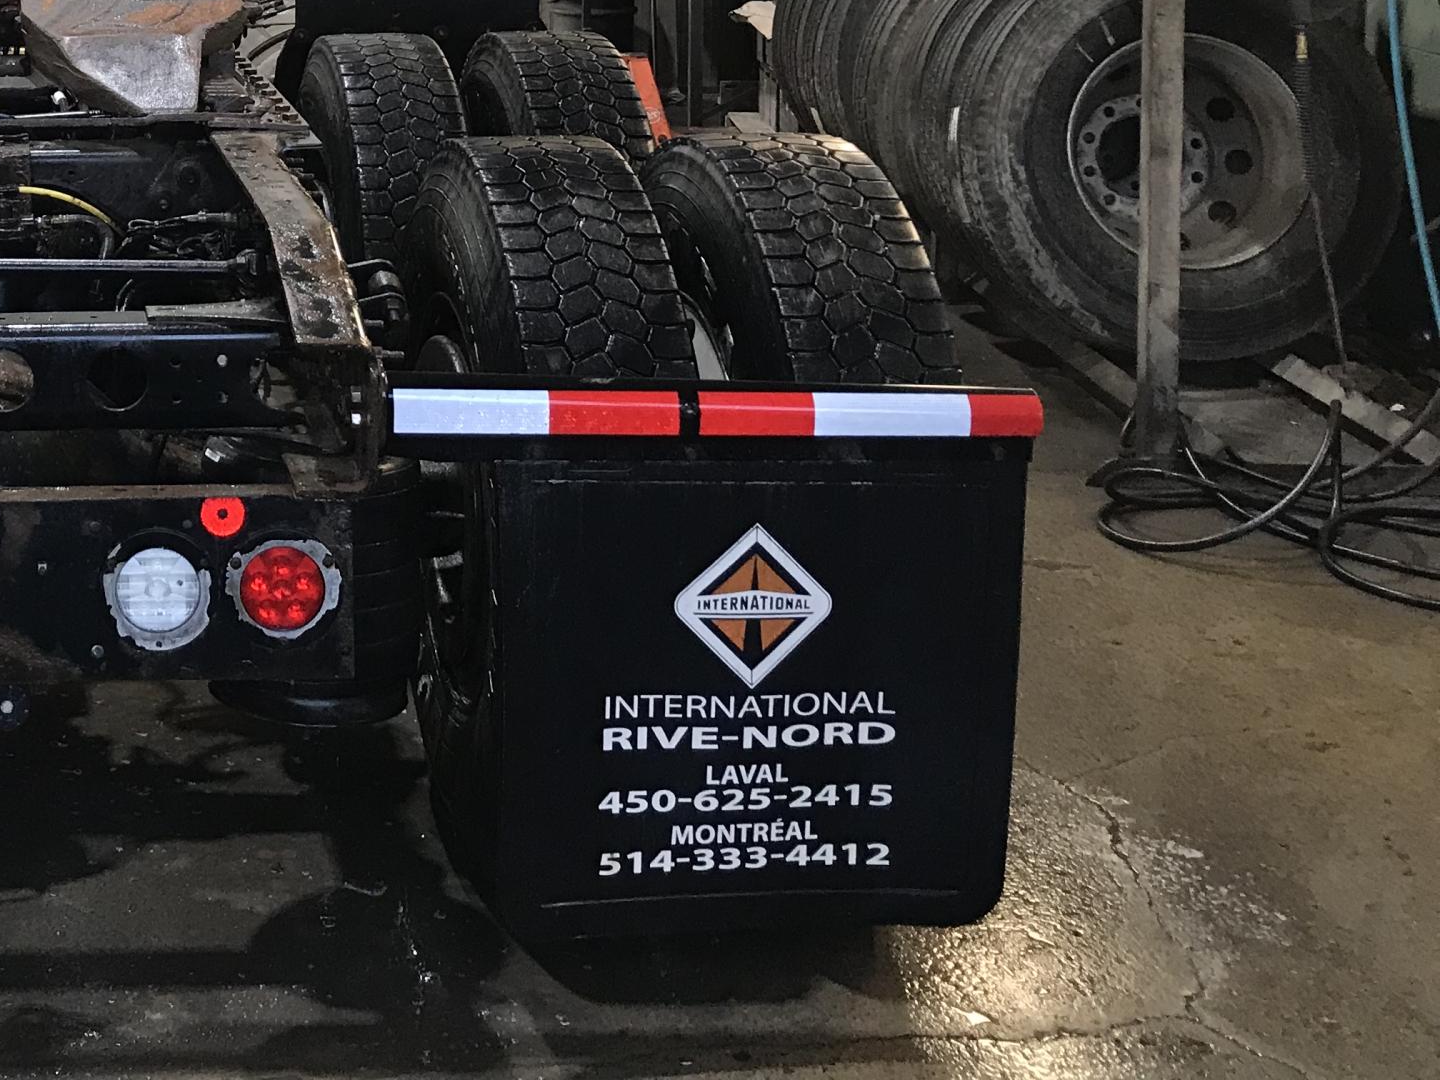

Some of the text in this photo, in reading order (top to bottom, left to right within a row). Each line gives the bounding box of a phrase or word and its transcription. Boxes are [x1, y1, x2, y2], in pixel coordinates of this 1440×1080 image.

[697, 595, 810, 611] INTERNATIONAL
[604, 691, 896, 720] INTERNATIONAL
[602, 721, 896, 751] RIVE-NORD
[705, 763, 790, 786] LAVAL
[598, 783, 893, 815] 450-625-2415
[670, 818, 819, 846] MONTRÉAL
[598, 843, 891, 876] 514-333-4412
